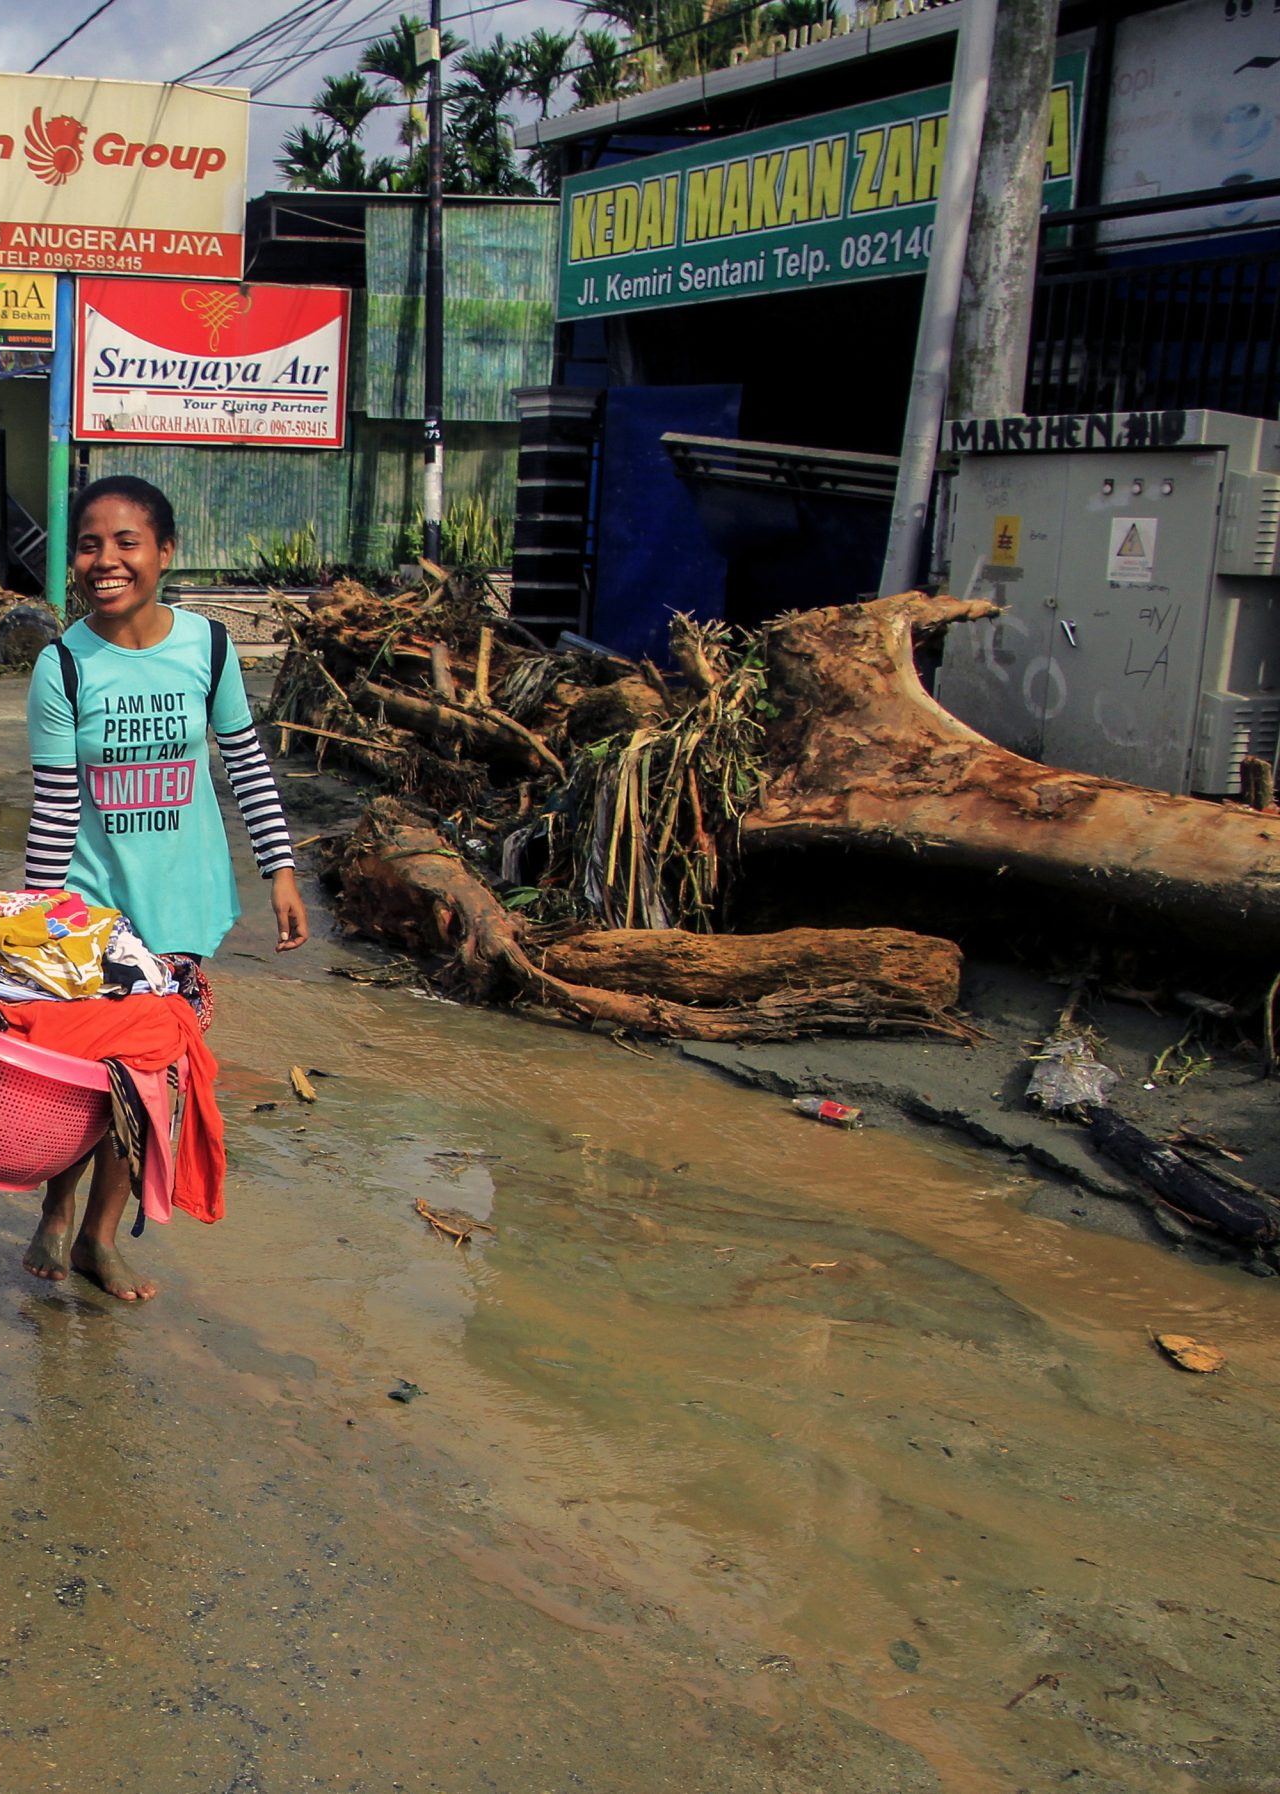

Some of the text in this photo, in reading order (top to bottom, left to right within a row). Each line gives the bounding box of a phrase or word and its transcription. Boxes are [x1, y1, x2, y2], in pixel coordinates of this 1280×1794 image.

[92, 132, 227, 180] Group
[569, 172, 680, 263] KEDAI
[683, 134, 847, 246] MAKAN
[10, 227, 156, 253] ANUGERAH
[162, 234, 224, 256] JAYA
[44, 251, 143, 270] 0967-593415
[577, 278, 600, 306] Jl.
[606, 265, 673, 302] Kemiri
[679, 251, 765, 293] Sentani
[773, 244, 831, 282] Telp.
[1, 310, 9, 319] &
[12, 310, 51, 321] Bekam
[93, 347, 329, 391] Sriwijaya Air
[183, 399, 327, 414] Your Flying Partner
[131, 415, 182, 432] ANUGRAH
[184, 416, 209, 433] JAYA
[212, 417, 253, 434] TRAVEL
[271, 420, 328, 437] 0967-593415
[104, 692, 185, 714] I AM NOT
[103, 715, 187, 743] PERFECT
[103, 743, 188, 763] BUT I AM
[89, 766, 190, 805] LIMITED
[104, 810, 180, 834] EDITION
